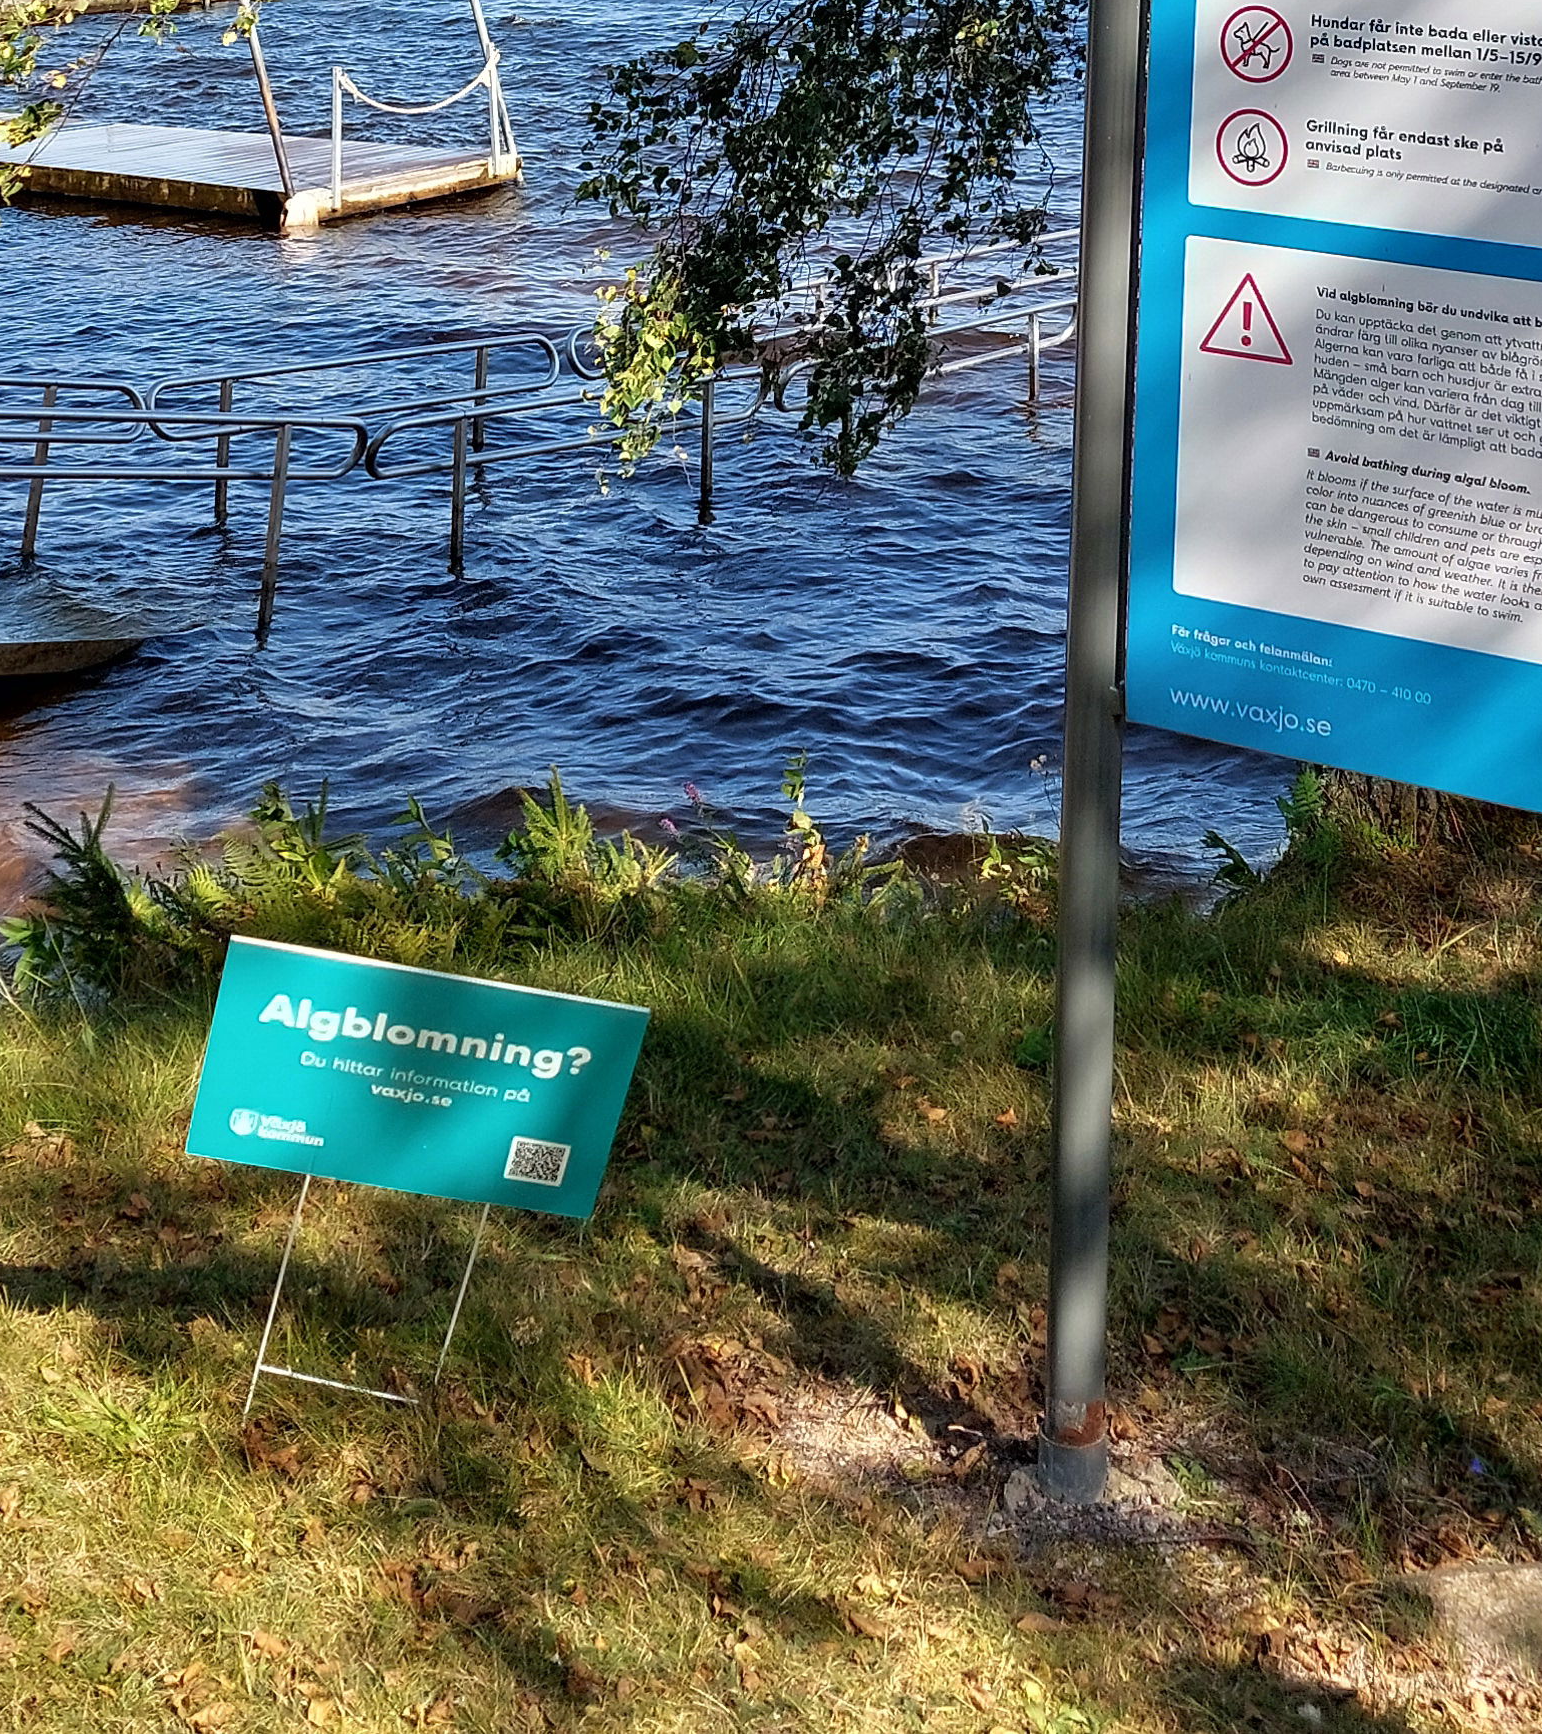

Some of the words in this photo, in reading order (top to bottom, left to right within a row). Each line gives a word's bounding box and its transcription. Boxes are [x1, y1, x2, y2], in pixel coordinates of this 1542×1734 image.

[1310, 13, 1366, 31] Hundar
[1368, 17, 1391, 33] får
[1395, 20, 1424, 36] inte
[1427, 23, 1468, 40] bada
[1472, 28, 1507, 44] eller
[1309, 31, 1329, 48] på
[1333, 34, 1416, 54] badplatsen
[1420, 44, 1471, 60] mellan
[1305, 139, 1361, 155] anvisad
[1365, 144, 1402, 160] plats
[1306, 119, 1368, 141] Grillning
[1372, 125, 1394, 140] får
[1398, 130, 1450, 147] endast
[1453, 134, 1479, 150] ske
[1482, 137, 1504, 155] på
[1316, 285, 1336, 299] Vid
[1338, 290, 1414, 313] algblomning
[1417, 299, 1439, 313] bör
[1441, 303, 1457, 316] du
[1459, 308, 1509, 323] undvika
[1512, 315, 1531, 327] att
[1324, 449, 1360, 465] Avoid
[1361, 455, 1408, 476] bathing
[1410, 464, 1451, 483] during
[1453, 472, 1487, 487] algal
[1170, 639, 1201, 658] Växjö
[1171, 623, 1190, 638] För
[1233, 639, 1256, 651] och
[1169, 687, 1331, 736] www.vaxjo.se
[258, 993, 591, 1079] Algblomning?
[299, 1050, 326, 1068] Du
[332, 1056, 383, 1077] hittar
[390, 1067, 498, 1097] information
[502, 1087, 530, 1102] på
[370, 1083, 452, 1107] vaxjo.se
